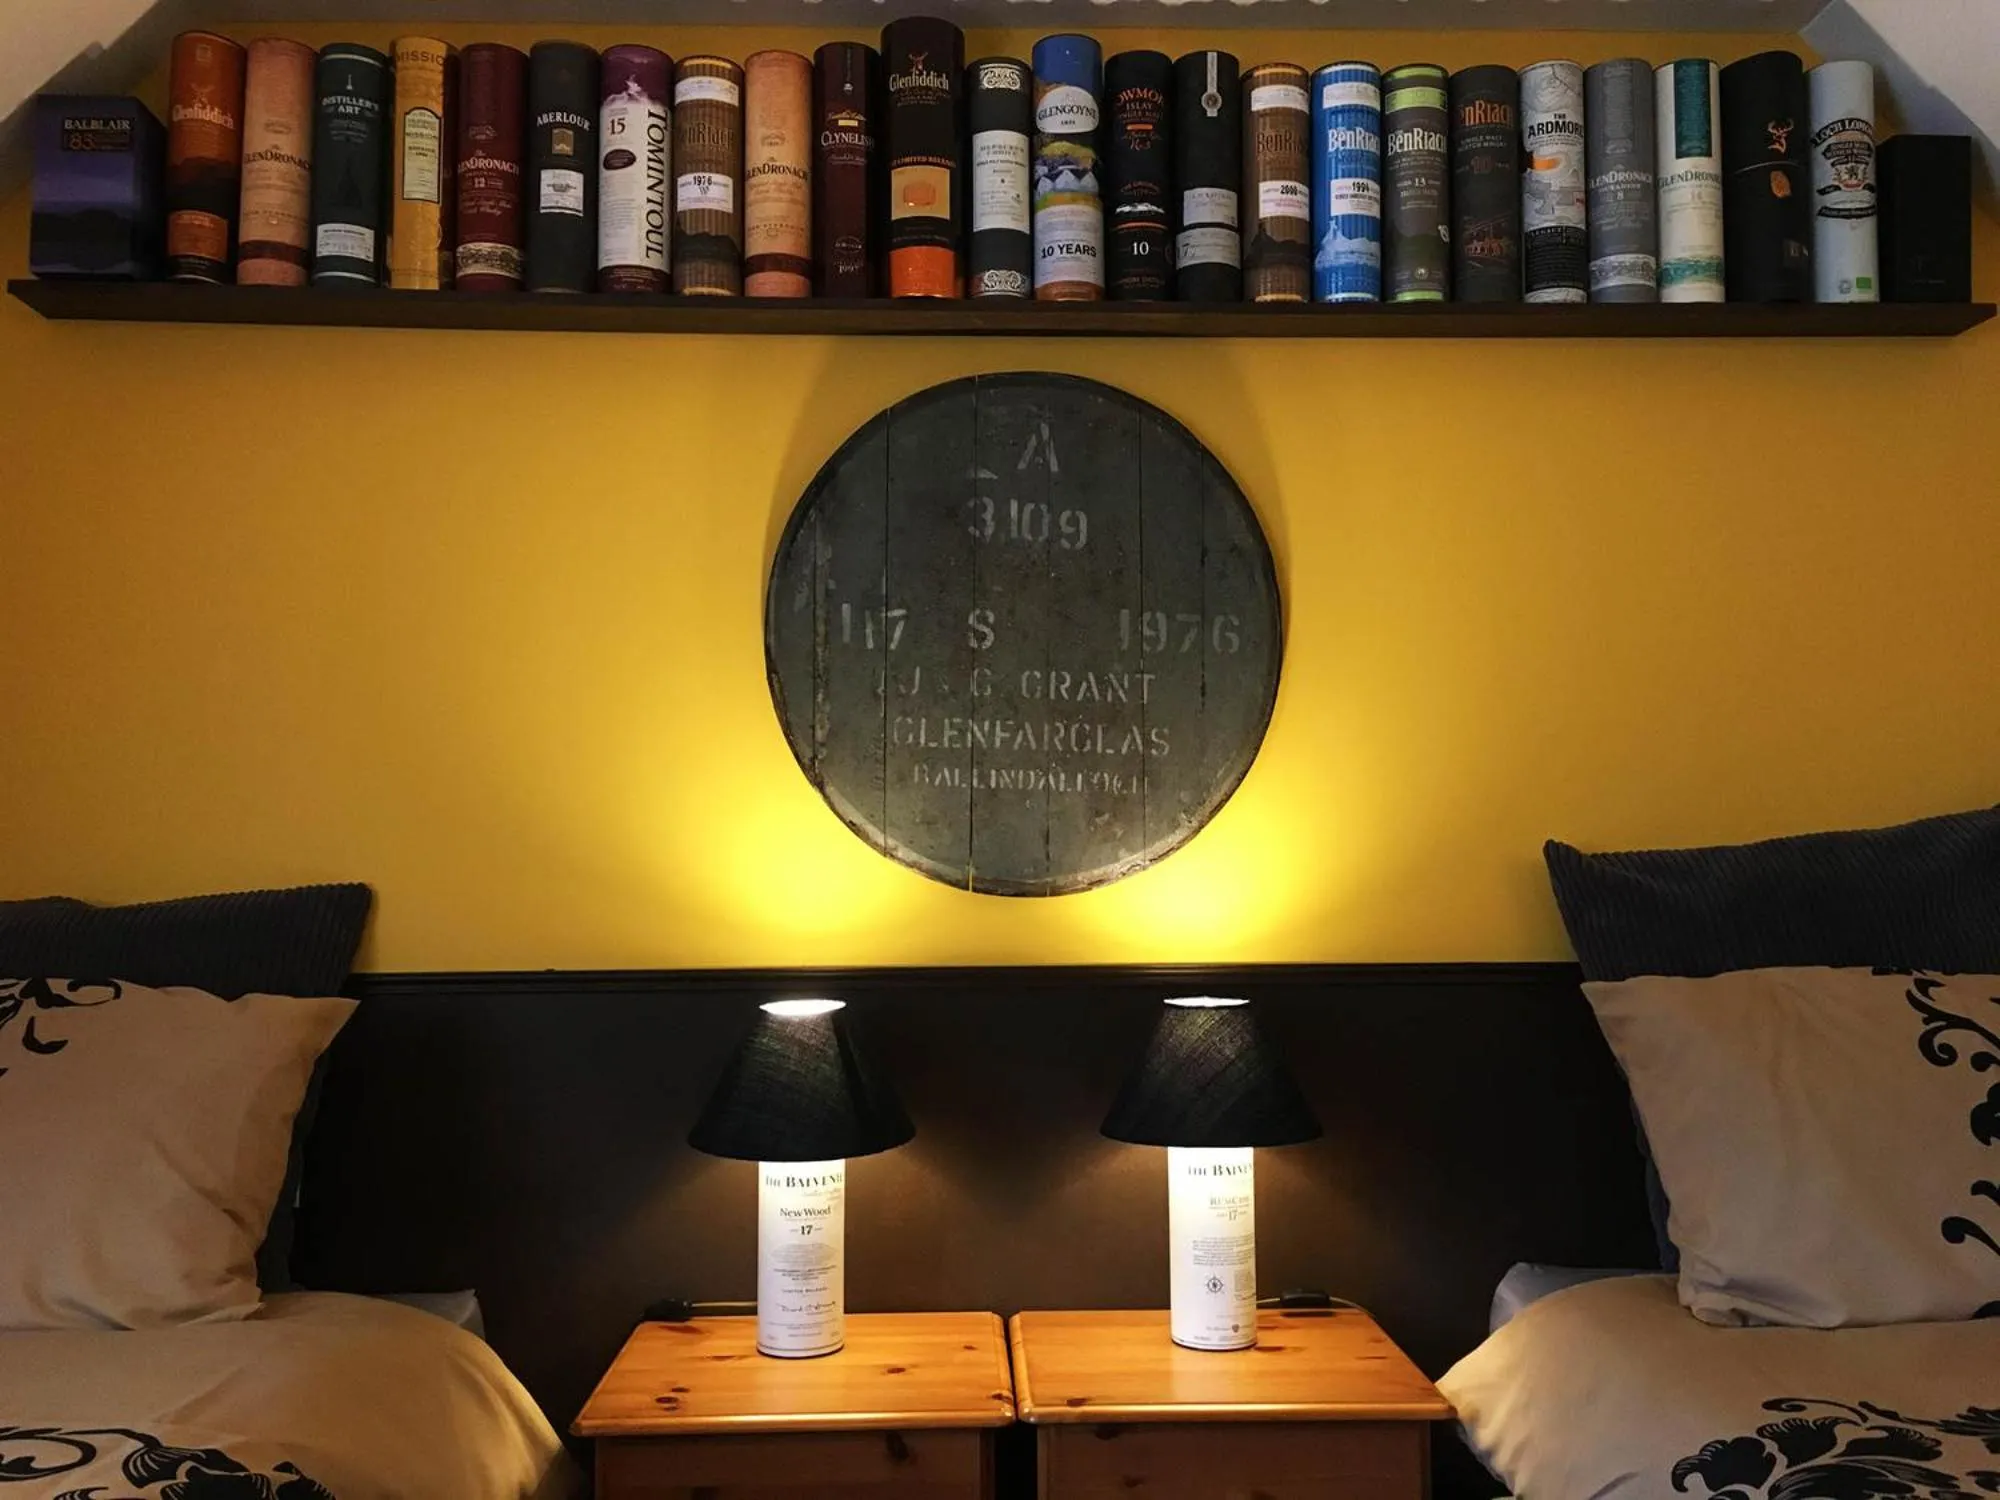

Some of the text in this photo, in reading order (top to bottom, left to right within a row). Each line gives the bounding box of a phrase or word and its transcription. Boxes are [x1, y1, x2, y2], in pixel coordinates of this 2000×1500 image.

[889, 67, 950, 92] Glenfiddich
[337, 104, 361, 115] ART
[1038, 104, 1097, 121] GLENGOYNE
[63, 118, 132, 130] BALBLAIR
[536, 111, 591, 132] ABERLOUR
[608, 117, 627, 136] 15
[646, 108, 669, 259] TOMINTOUL
[1041, 243, 1097, 259] 10 YEARS
[1131, 241, 1150, 256] 10
[1016, 421, 1059, 473] A
[967, 607, 995, 650] S
[1118, 606, 1241, 656] 1976
[1021, 669, 1156, 705] GRANT
[892, 714, 1171, 757] GLENFARCLAS
[779, 1205, 831, 1218] New Wood
[800, 1224, 814, 1236] 17
